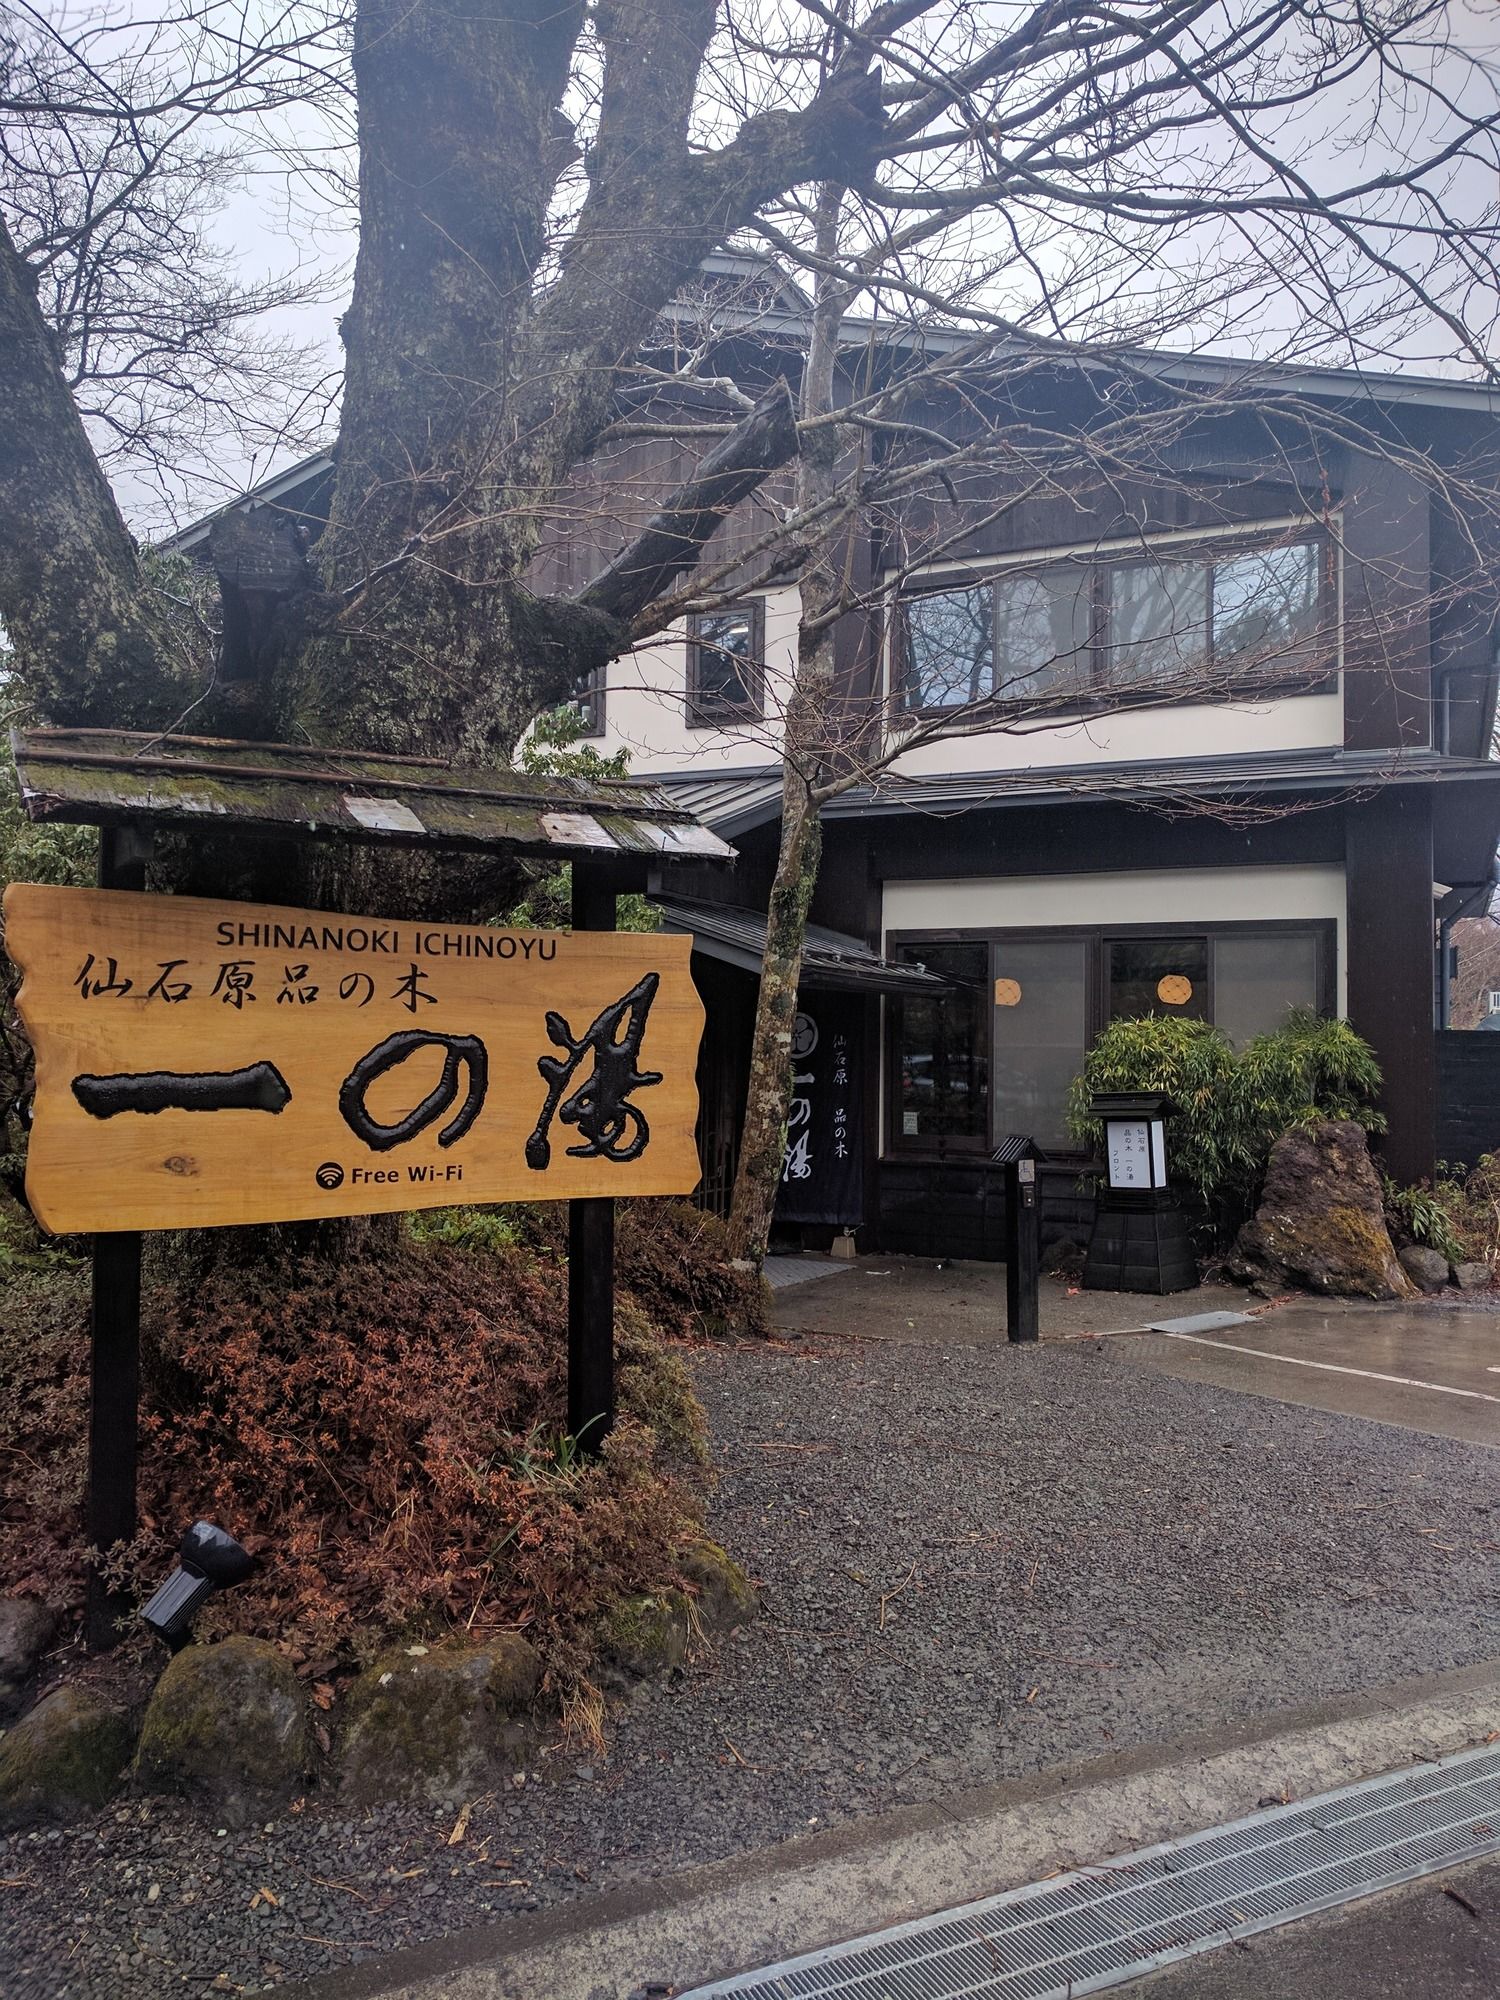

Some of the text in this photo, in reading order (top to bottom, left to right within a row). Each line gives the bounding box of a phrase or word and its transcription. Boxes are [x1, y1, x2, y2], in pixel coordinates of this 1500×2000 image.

[216, 921, 558, 961] SHINANOKI ICHINOYU
[73, 953, 439, 1014] 仙石原品の木
[70, 971, 664, 1171] 一の湯
[832, 1034, 849, 1159] 仙石原 品の木
[351, 1164, 464, 1184] Free Wi-Fi
